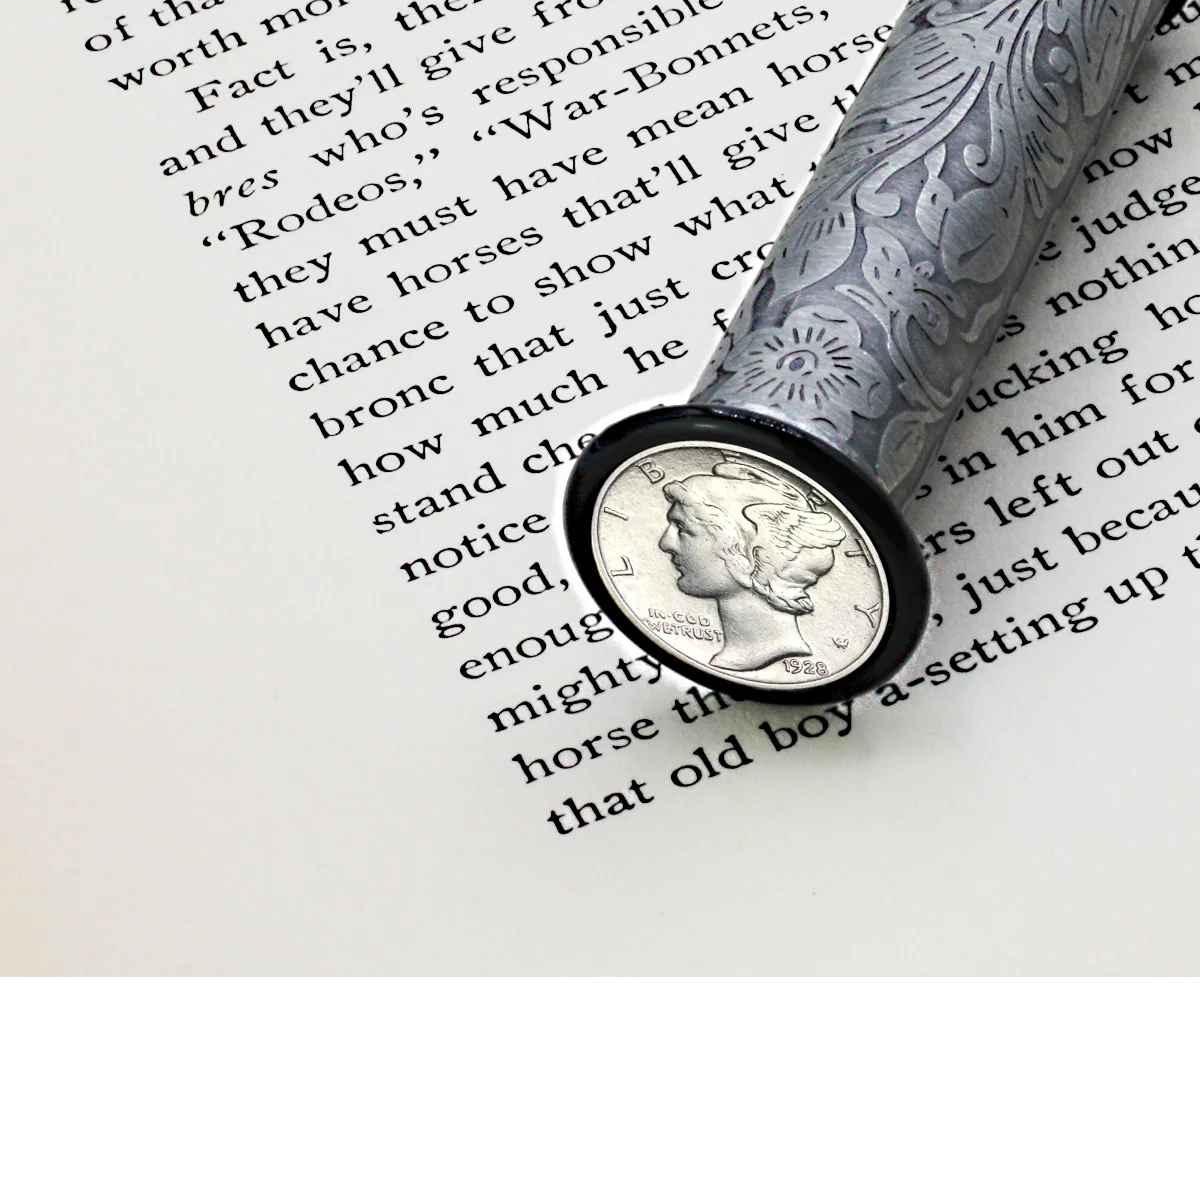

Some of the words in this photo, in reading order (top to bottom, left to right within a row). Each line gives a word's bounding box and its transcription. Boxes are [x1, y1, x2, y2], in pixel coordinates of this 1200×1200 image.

[108, 29, 247, 91] worth
[185, 60, 295, 113] Fact
[316, 38, 372, 63] is,
[160, 124, 247, 176] and
[420, 27, 516, 81] give
[183, 170, 278, 217] bres
[309, 106, 444, 167] who's
[233, 252, 332, 302] they
[358, 196, 477, 256] must
[492, 148, 607, 201] have
[627, 87, 754, 148] mean
[387, 227, 543, 297] horses
[723, 115, 820, 170] give
[289, 321, 449, 391] chance
[535, 236, 651, 297] show
[309, 375, 454, 439] bronc
[594, 278, 689, 338] just
[471, 369, 608, 437] much
[372, 462, 507, 534] stand
[984, 473, 1082, 526] left
[400, 514, 550, 582] notice
[956, 547, 1058, 614] just
[431, 562, 569, 639] good,
[547, 779, 655, 835] that
[670, 734, 754, 787] old
[876, 597, 1098, 706] a-setting
